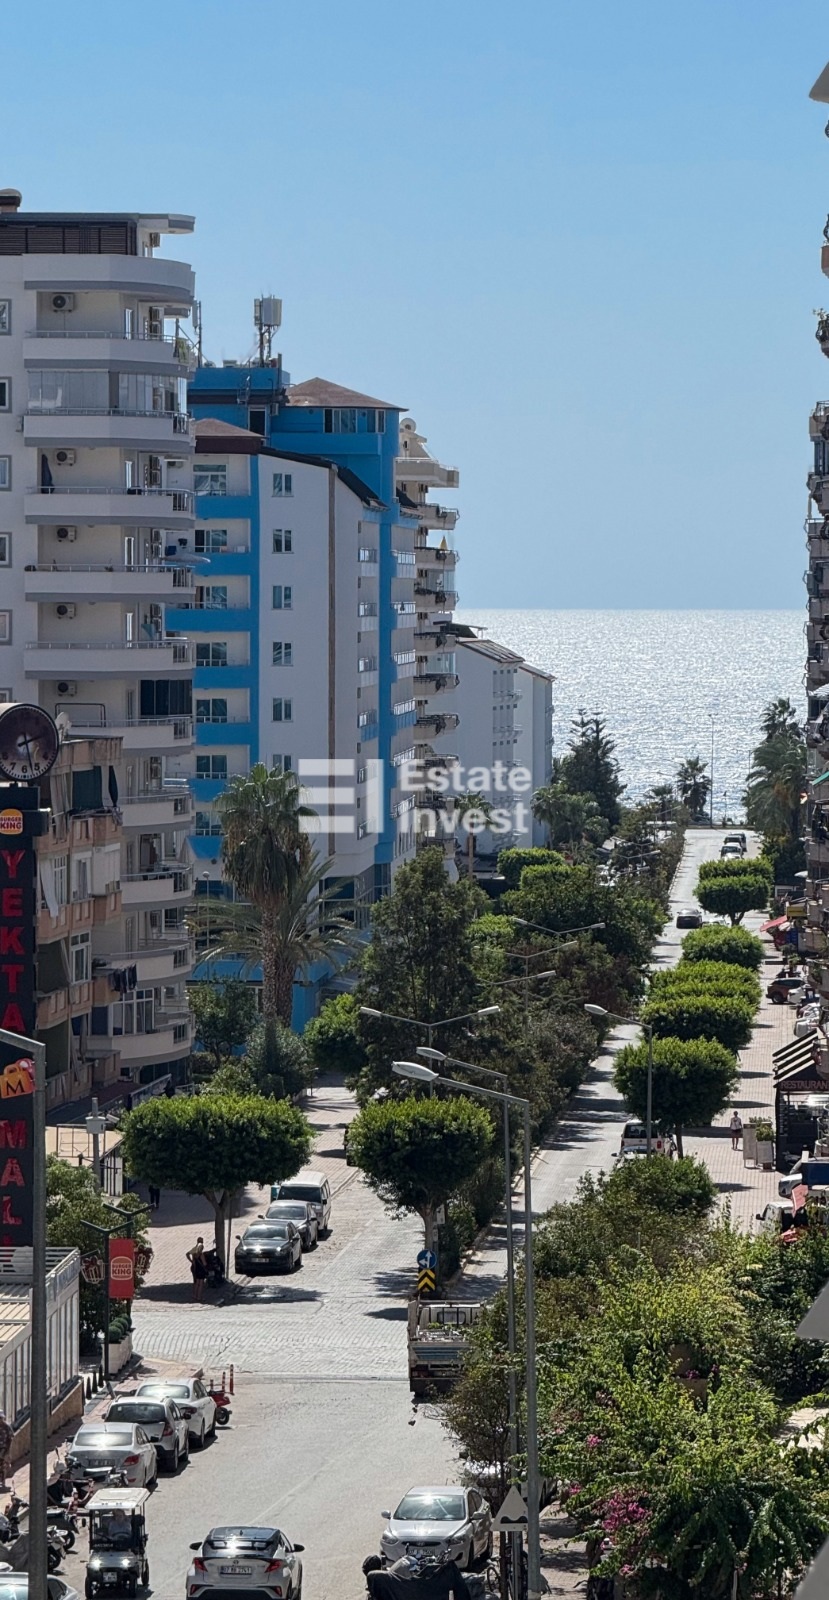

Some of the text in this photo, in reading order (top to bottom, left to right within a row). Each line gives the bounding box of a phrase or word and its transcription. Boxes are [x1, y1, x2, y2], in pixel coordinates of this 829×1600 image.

[10, 762, 16, 770] 7
[22, 765, 28, 773] 6
[34, 762, 40, 770] 5
[0, 849, 26, 1034] YEKTA
[6, 1079, 25, 1096] M
[0, 1119, 26, 1247] MAL
